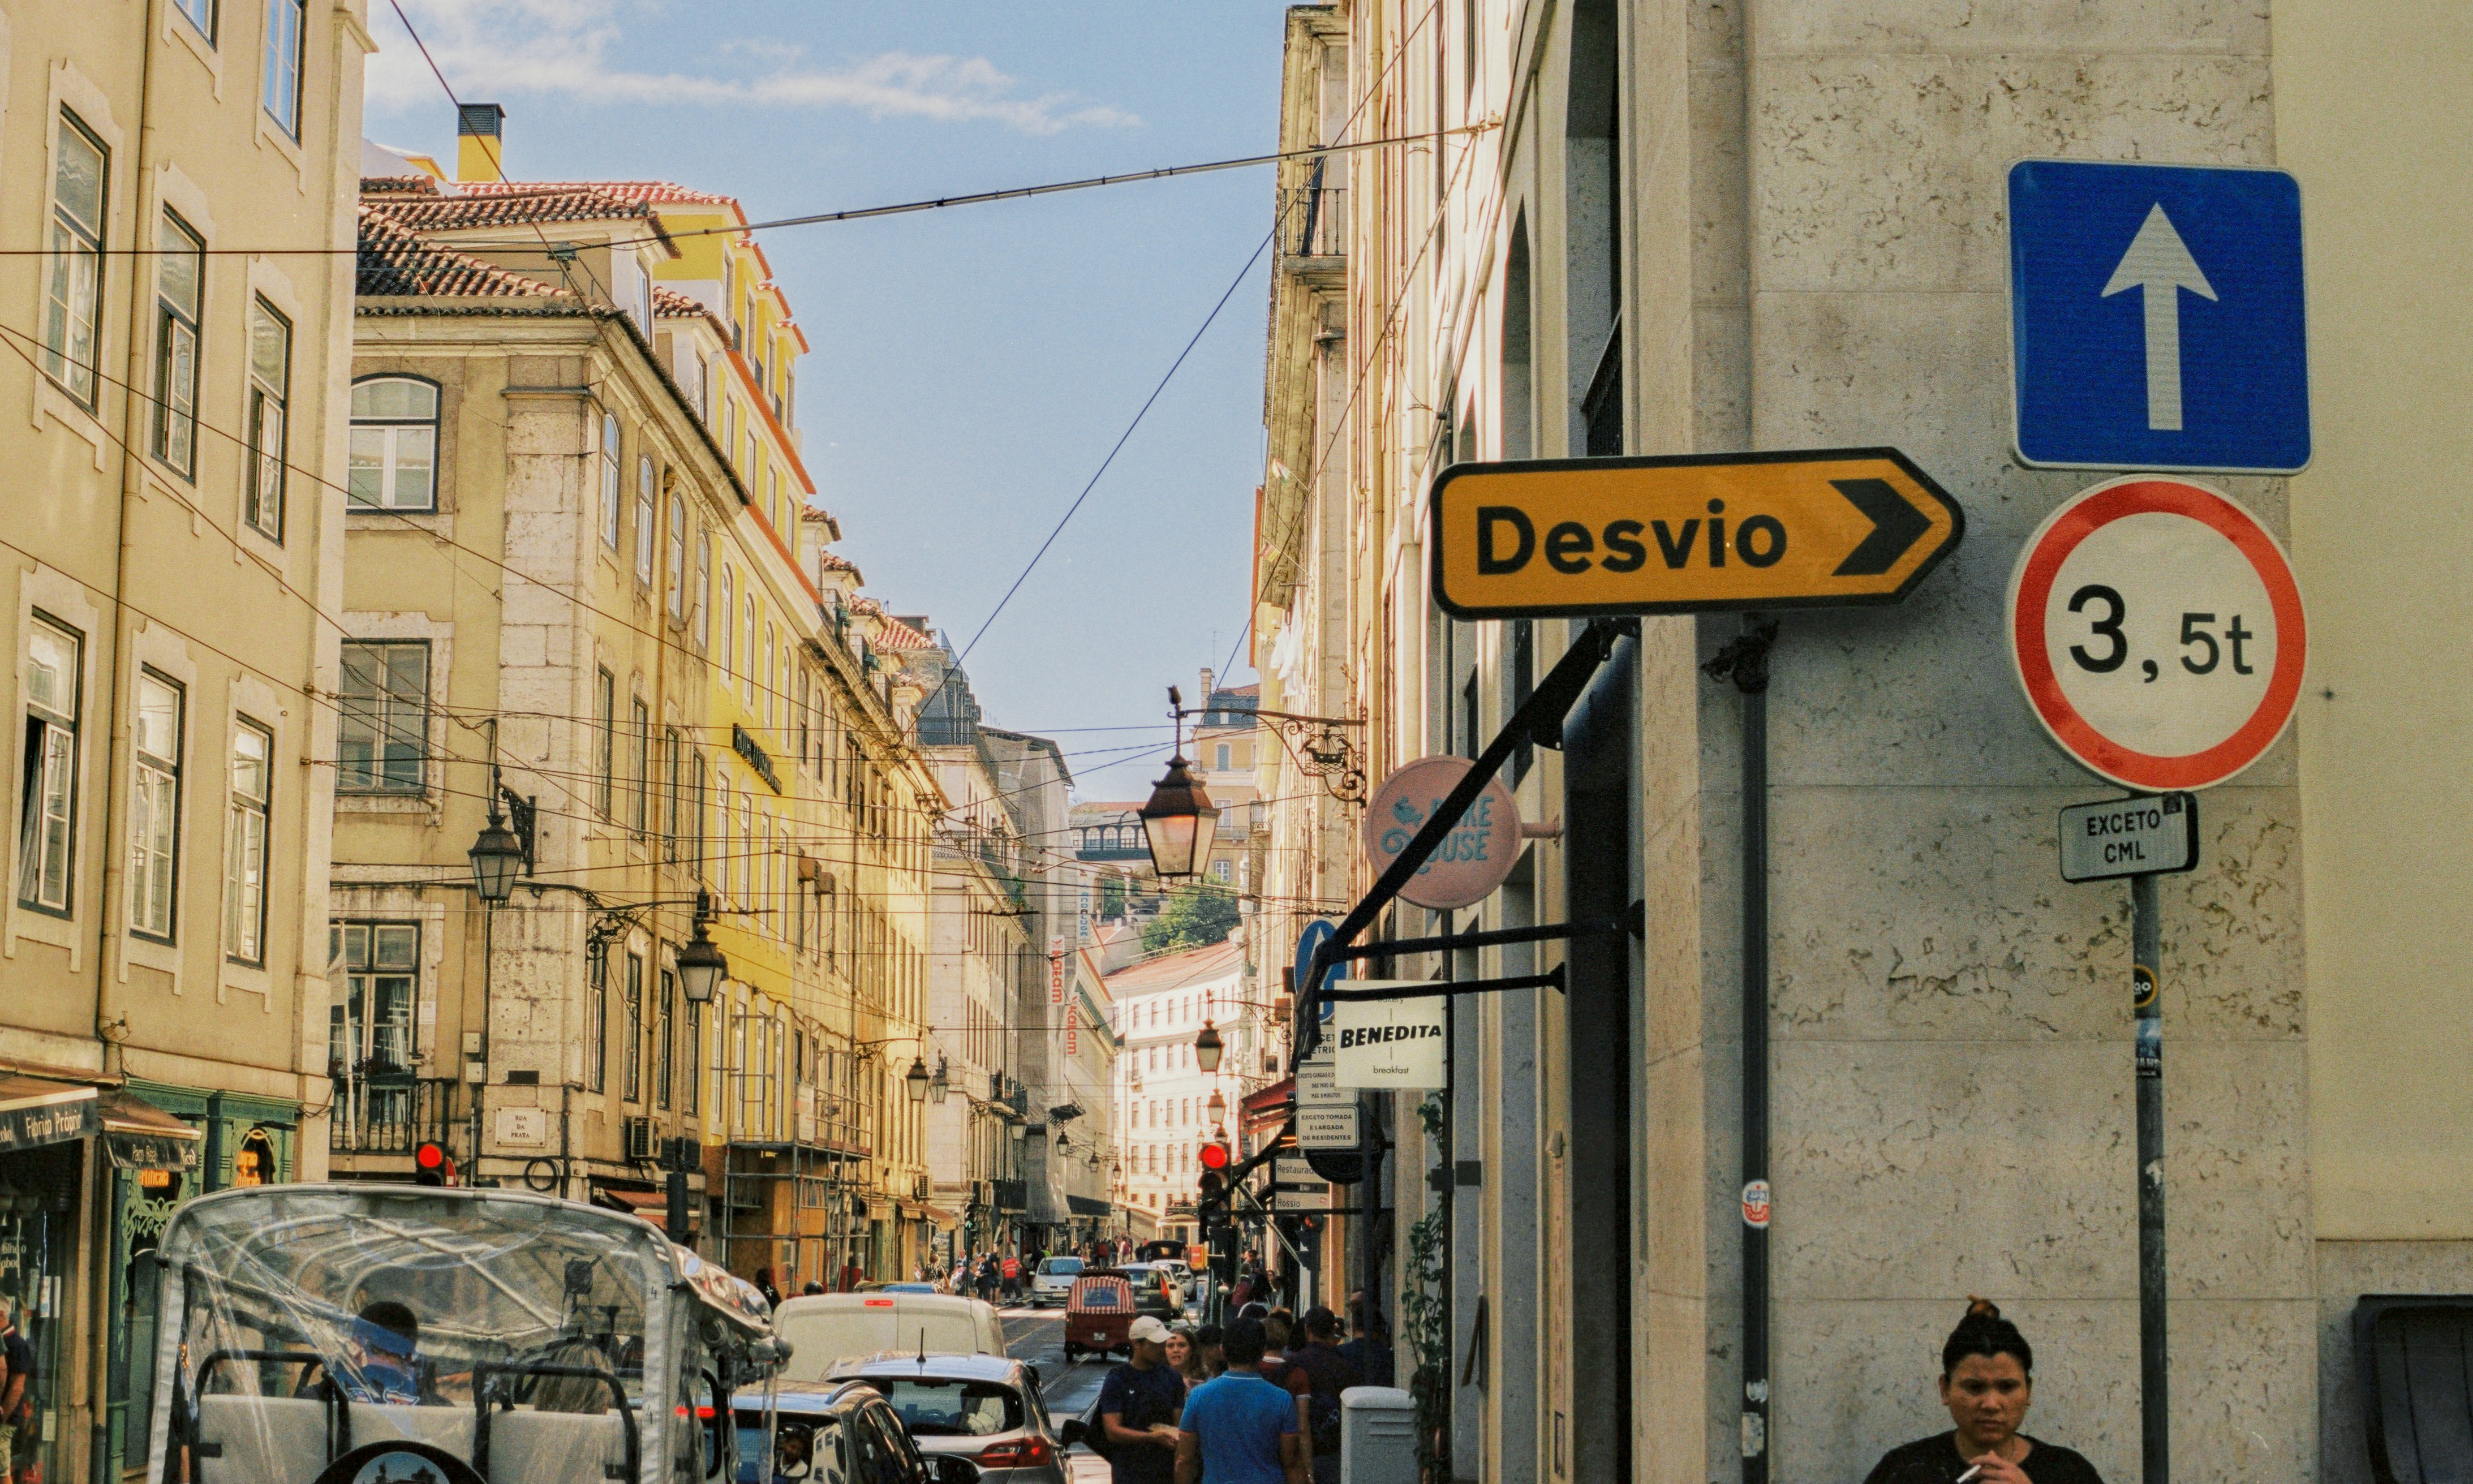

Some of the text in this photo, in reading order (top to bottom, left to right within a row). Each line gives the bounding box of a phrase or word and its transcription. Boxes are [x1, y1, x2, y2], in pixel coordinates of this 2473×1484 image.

[1476, 498, 1788, 576] Desvio
[2067, 584, 2253, 683] 3,5t
[2087, 808, 2160, 836] EXCETO
[2105, 841, 2145, 863] CML
[1340, 1025, 1442, 1049] BENEDITA
[1373, 1065, 1409, 1074] breakfast
[1278, 1199, 1301, 1207] Rossio
